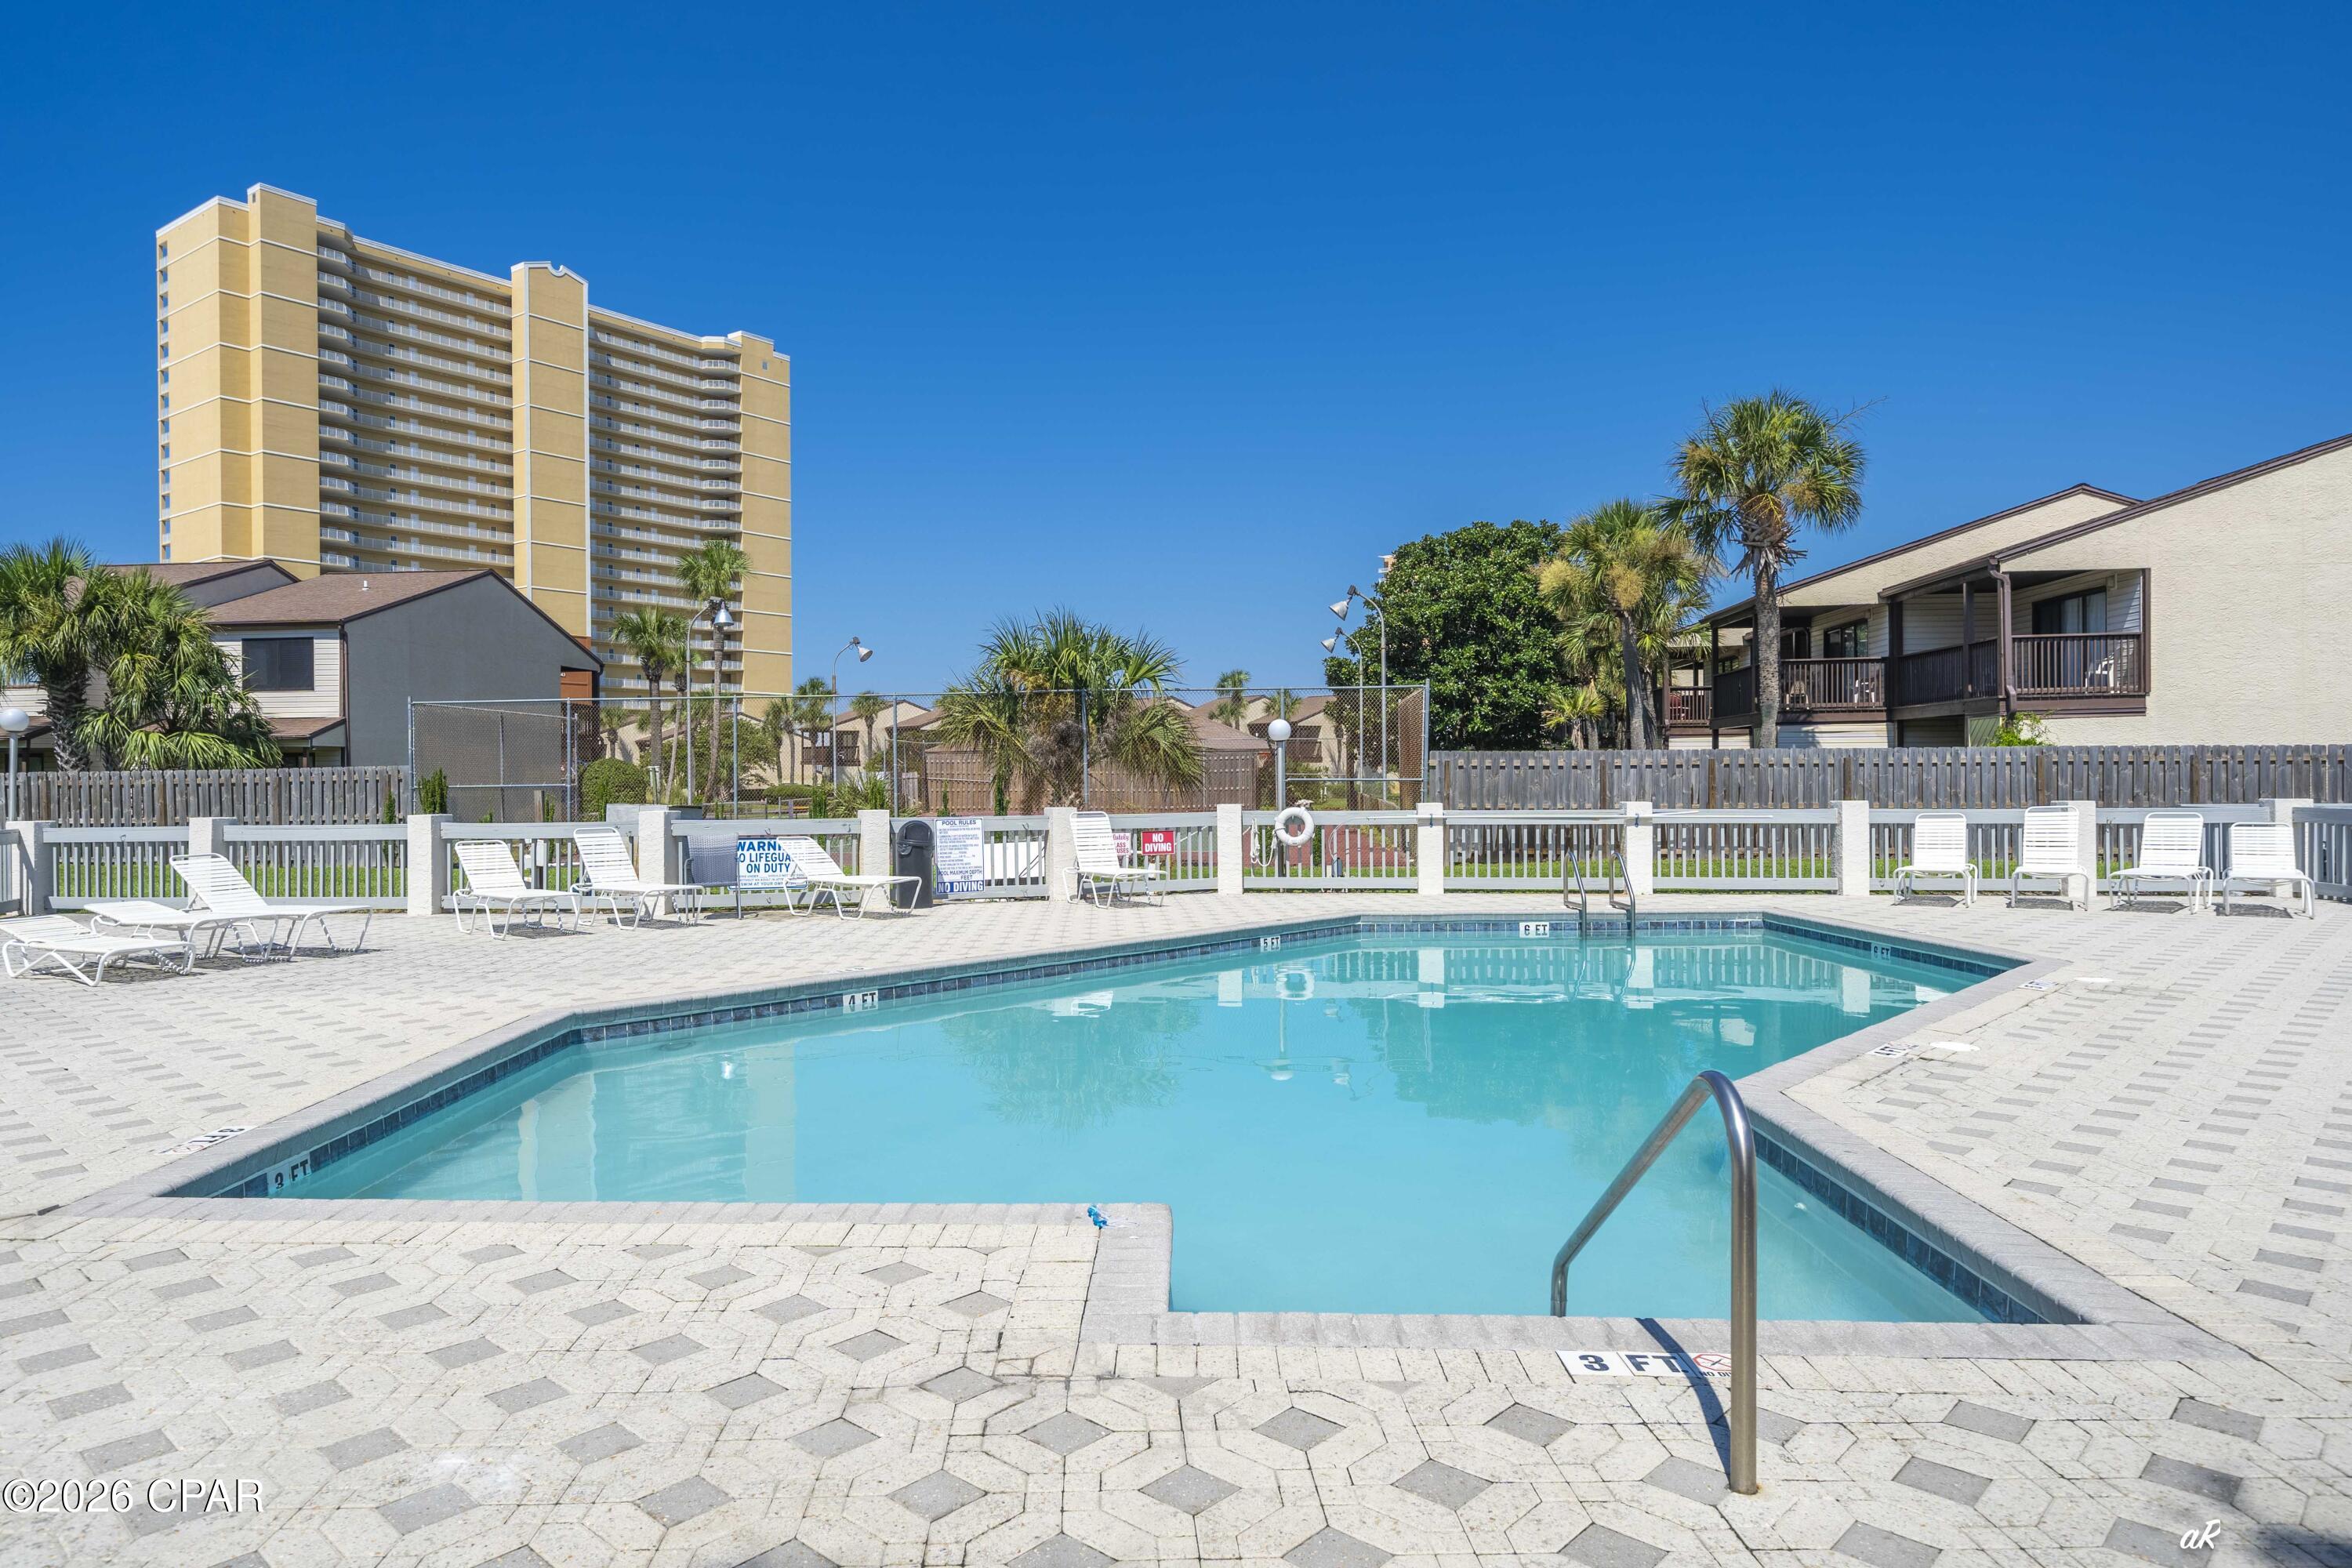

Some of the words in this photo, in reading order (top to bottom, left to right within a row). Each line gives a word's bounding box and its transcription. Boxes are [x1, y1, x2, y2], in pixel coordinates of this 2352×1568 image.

[1152, 833, 1164, 843] NO
[1145, 843, 1172, 852] DIVING
[750, 852, 791, 862] LIFEGUA
[746, 863, 760, 873] ON
[764, 862, 790, 873] DUTY
[938, 882, 951, 893] NO
[953, 881, 983, 892] DIVING
[275, 1172, 284, 1189] 3
[289, 1159, 309, 1182] FT
[1578, 1354, 1610, 1372] 3
